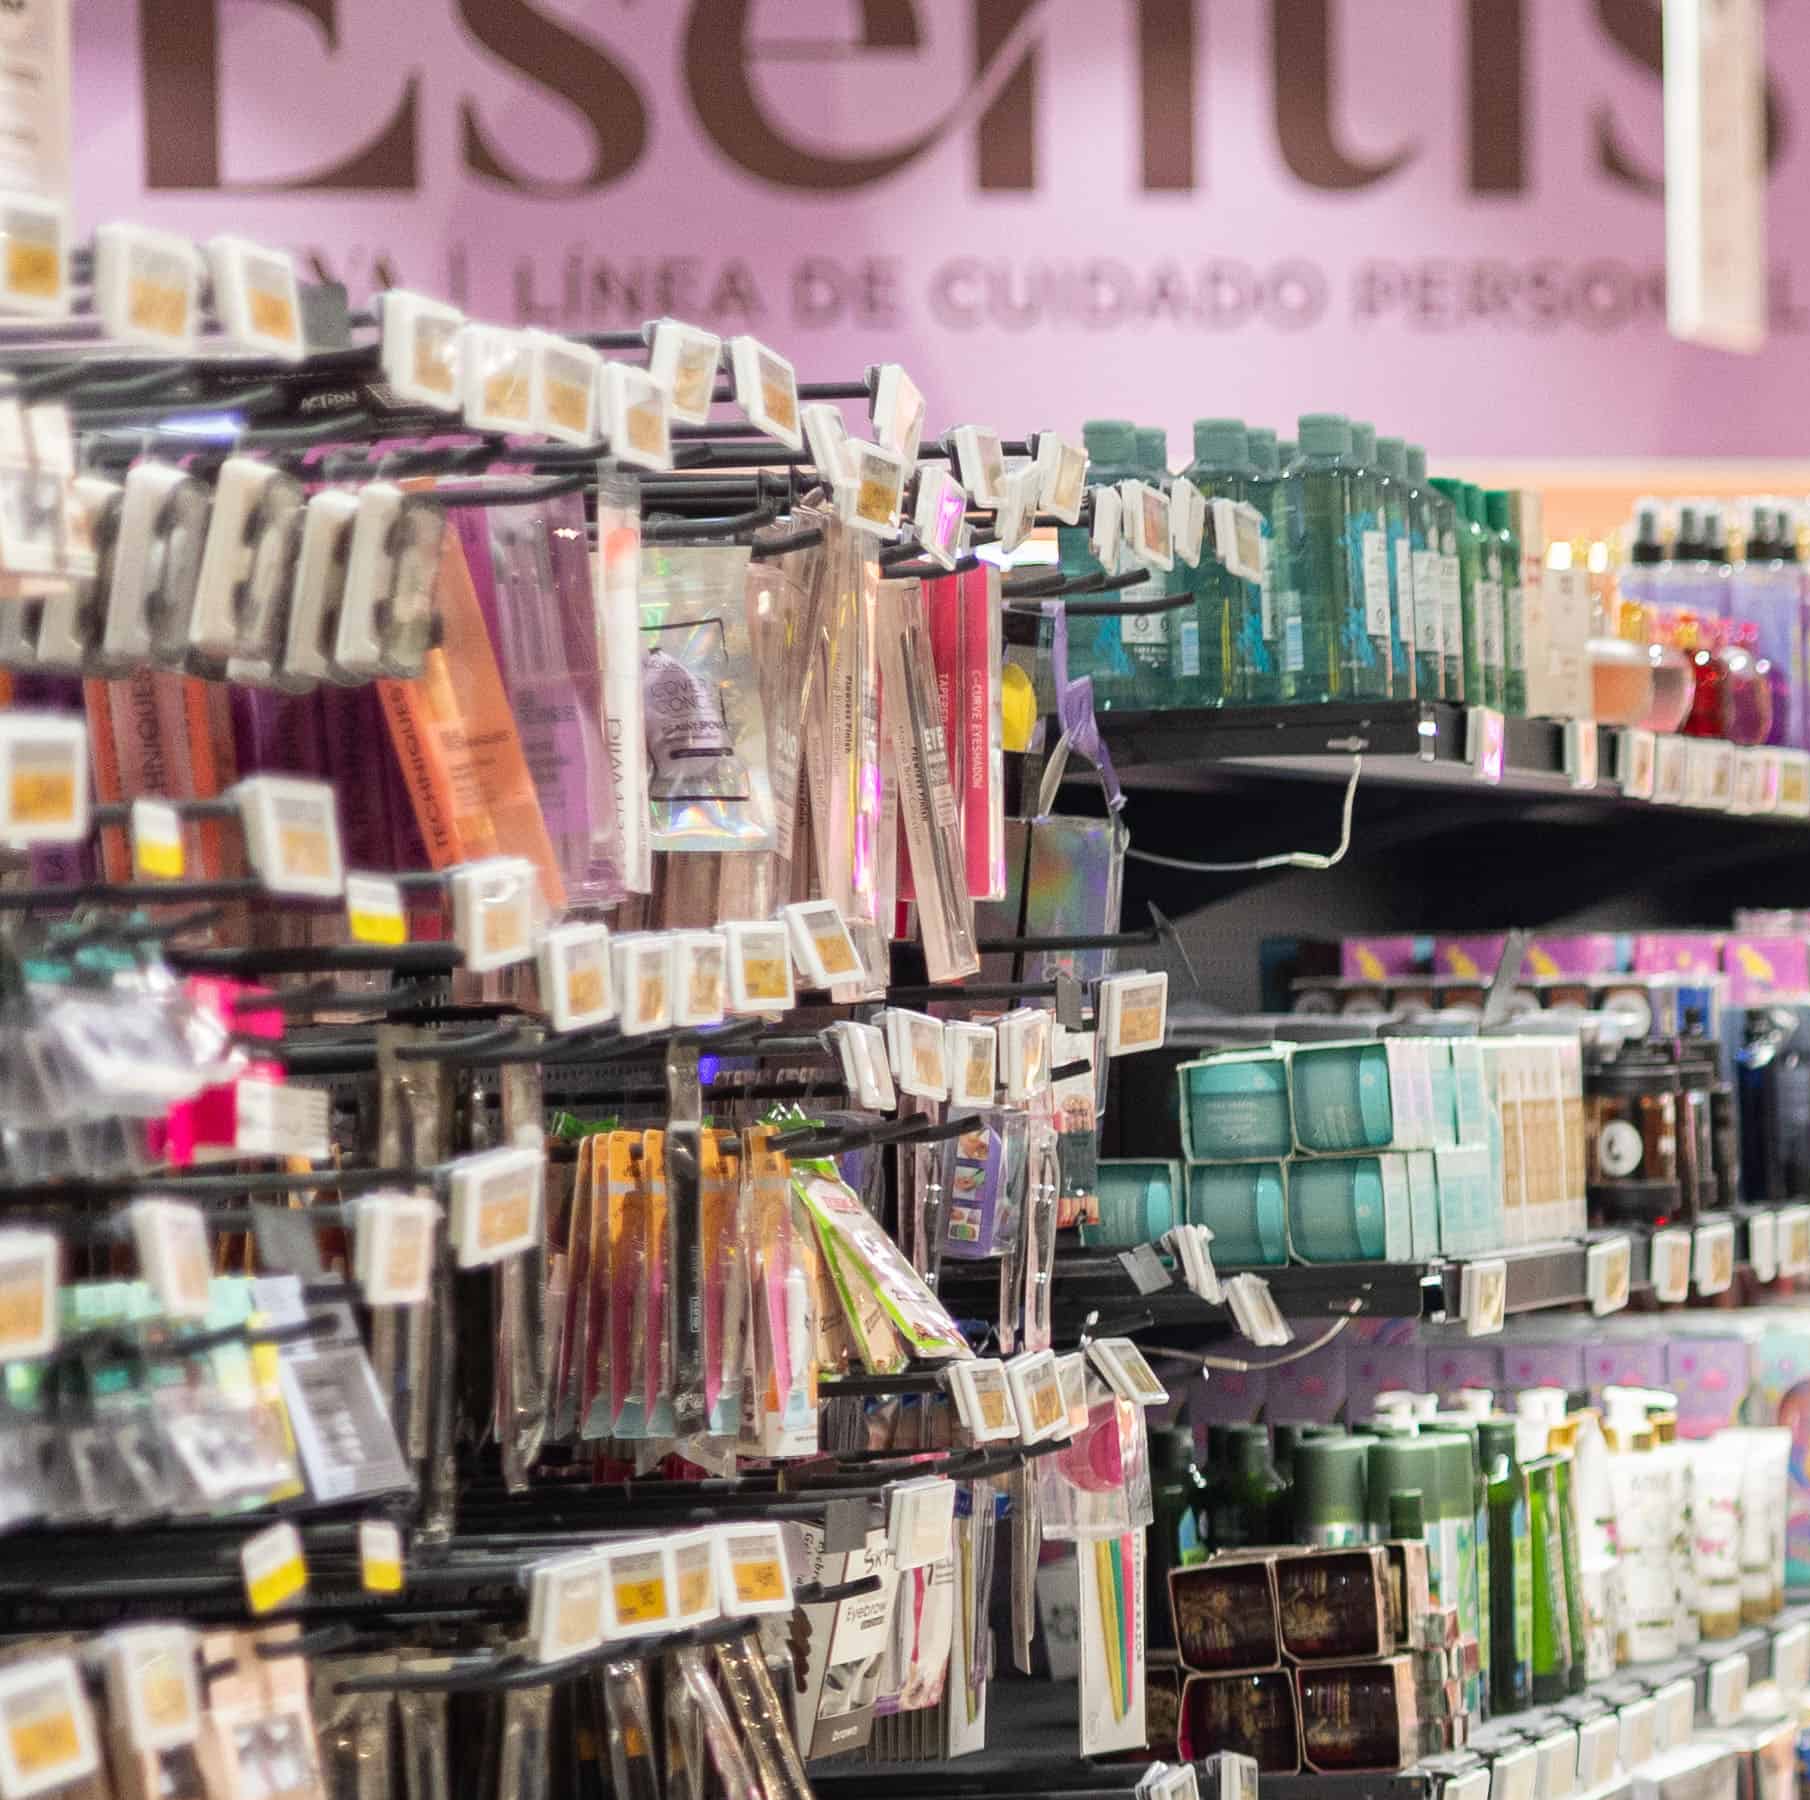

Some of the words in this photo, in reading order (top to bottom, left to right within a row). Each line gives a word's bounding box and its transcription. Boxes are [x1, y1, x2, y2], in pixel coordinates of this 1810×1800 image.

[140, 0, 1790, 196] Esenti
[515, 240, 763, 322] LÍNEA
[795, 258, 901, 325] DE
[928, 257, 1327, 331] CUIDADO
